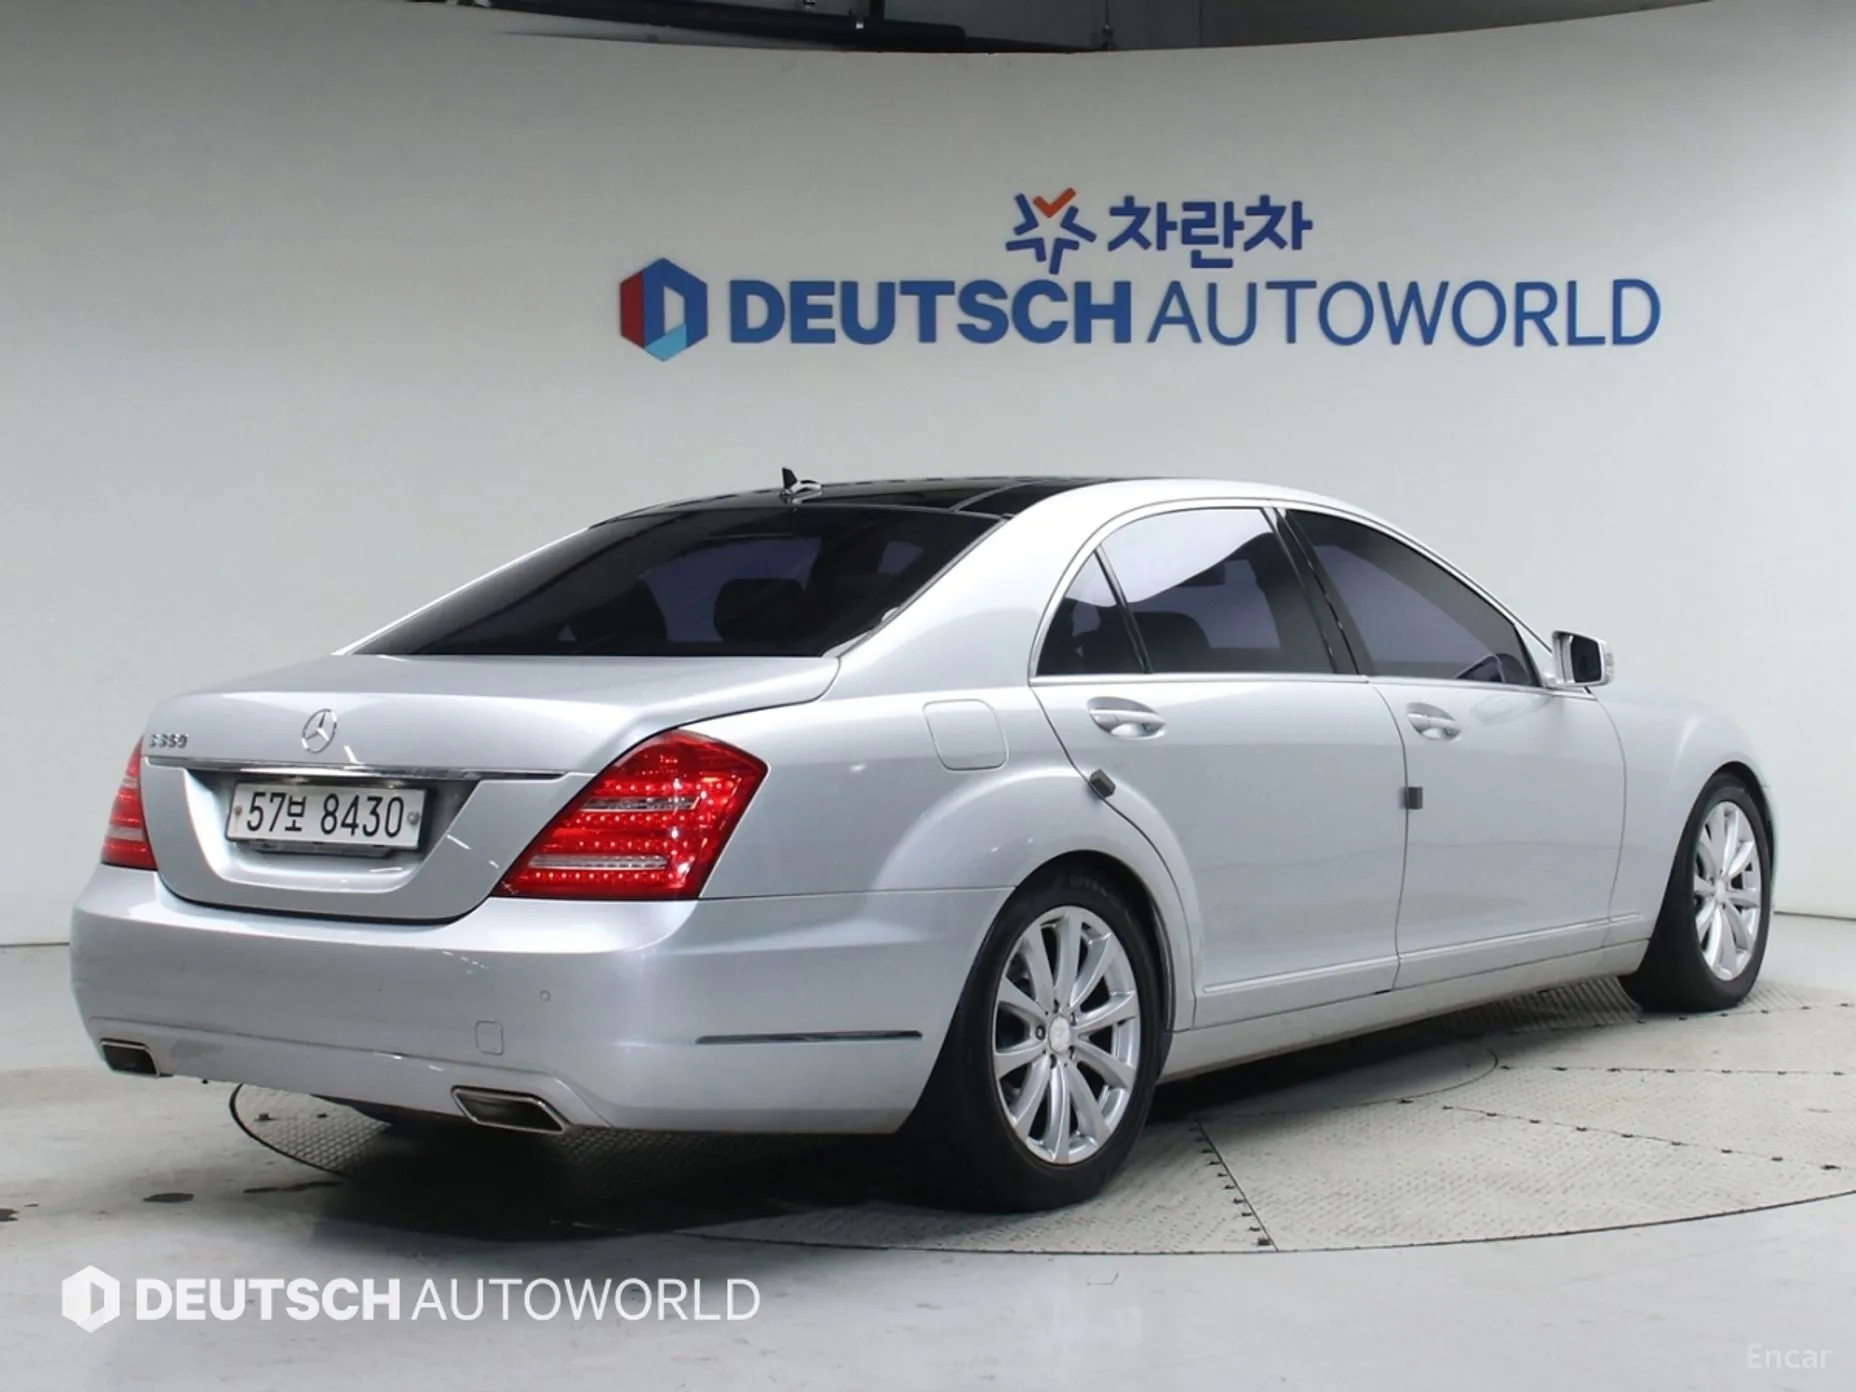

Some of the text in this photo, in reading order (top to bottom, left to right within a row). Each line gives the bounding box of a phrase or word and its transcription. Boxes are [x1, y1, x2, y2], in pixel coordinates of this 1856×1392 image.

[1108, 195, 1313, 268] 차란차
[730, 279, 1661, 347] DEUTSCH AUTOWORLD
[247, 791, 404, 838] 57보 8430
